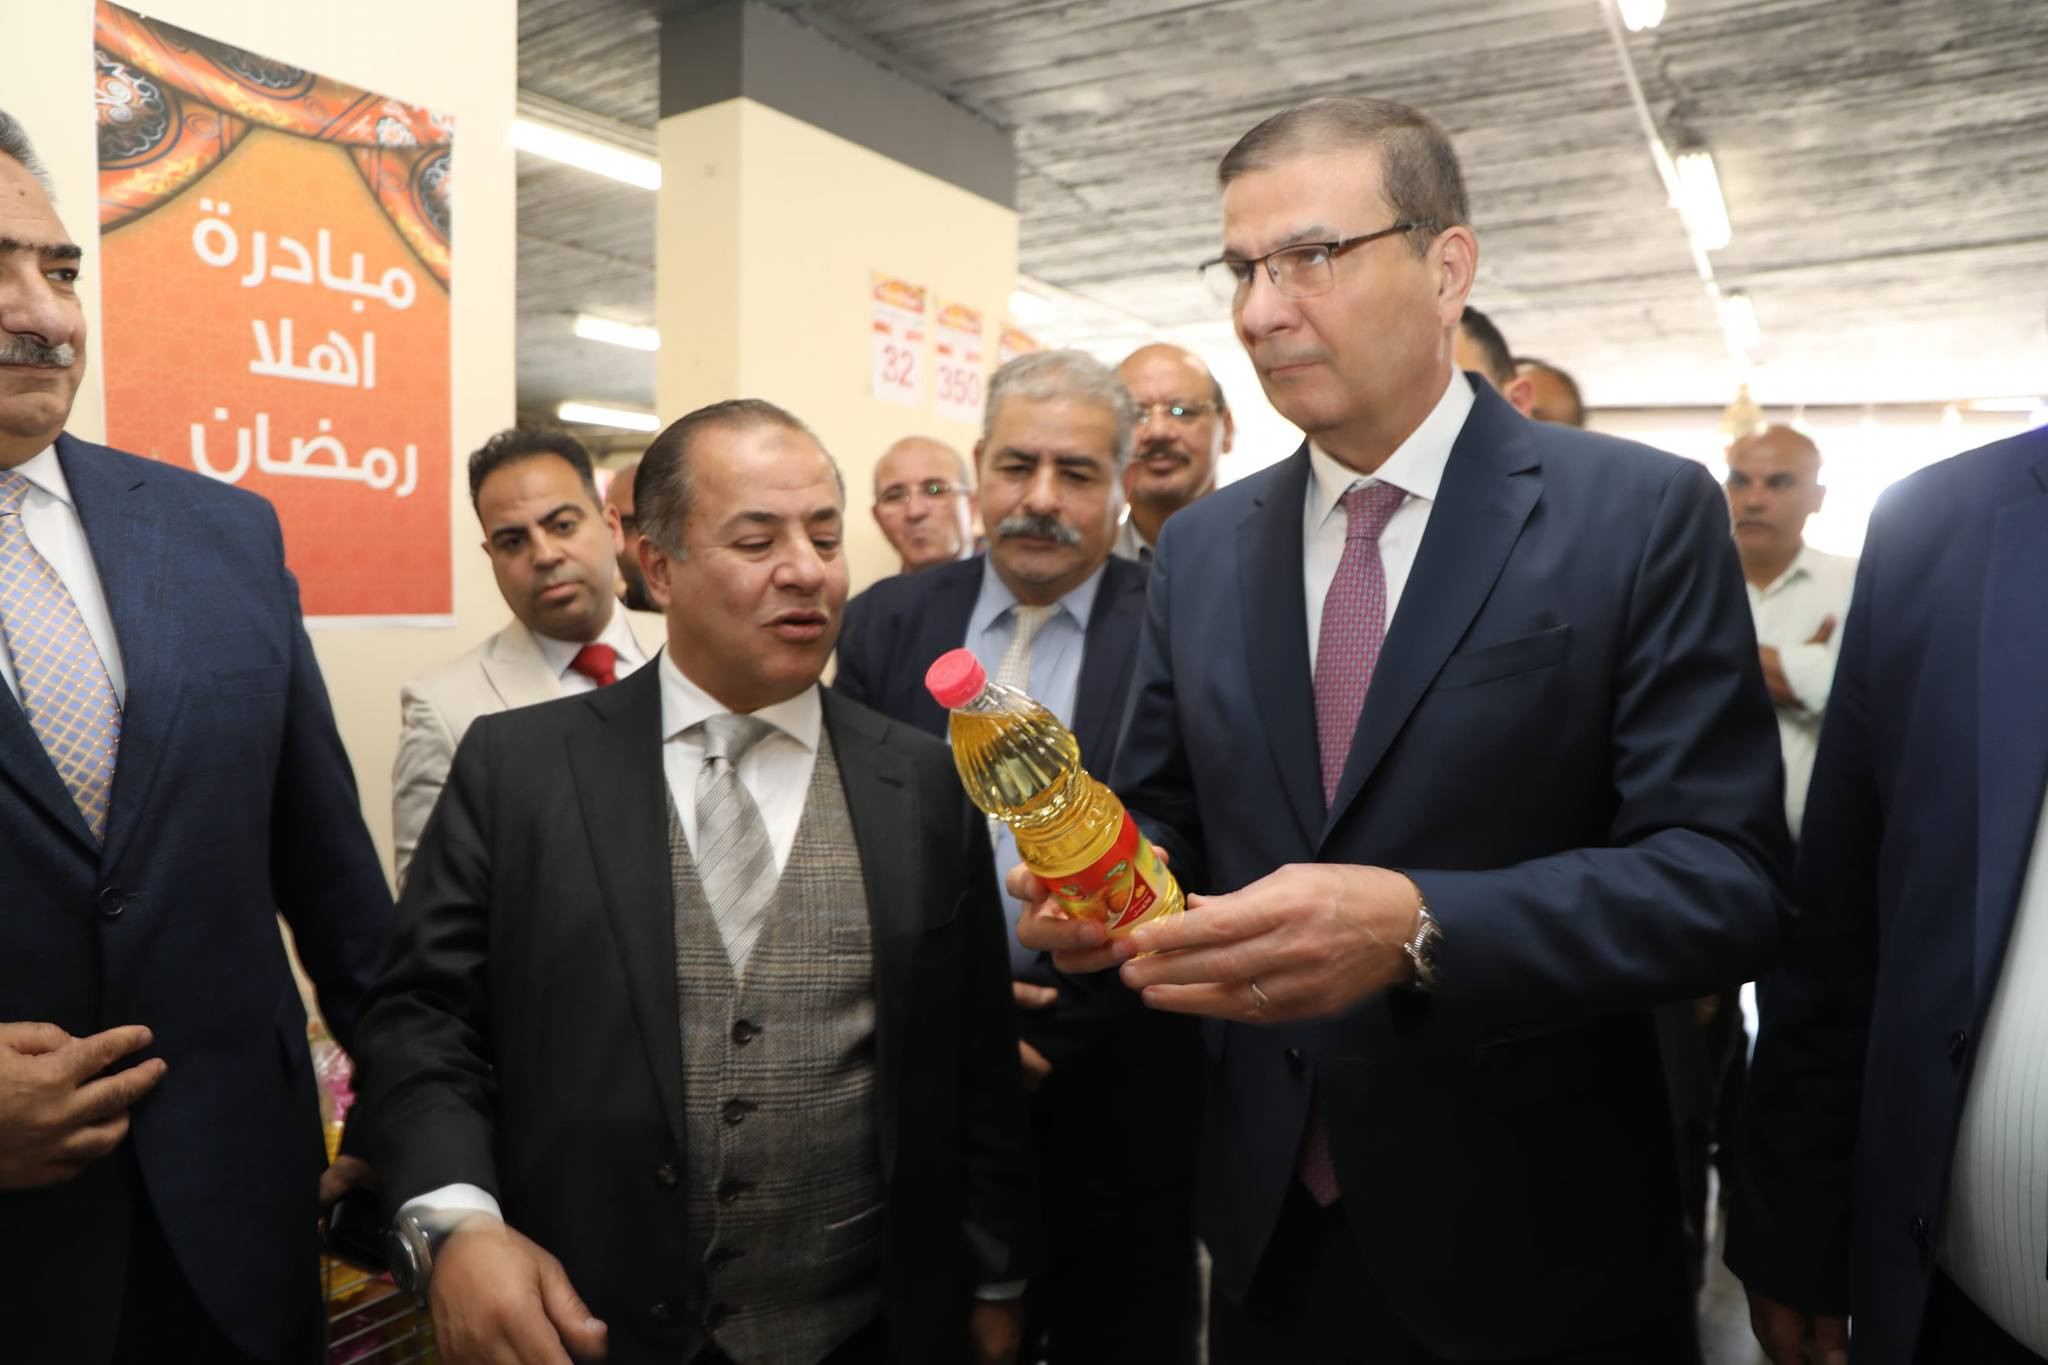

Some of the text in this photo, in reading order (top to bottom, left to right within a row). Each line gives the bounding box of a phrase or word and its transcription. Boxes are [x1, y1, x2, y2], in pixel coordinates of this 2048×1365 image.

[192, 198, 416, 312] مبادرة
[249, 317, 375, 389] اهلا
[882, 344, 914, 389] 32
[938, 364, 981, 407] 350
[190, 406, 418, 497] رمضان
